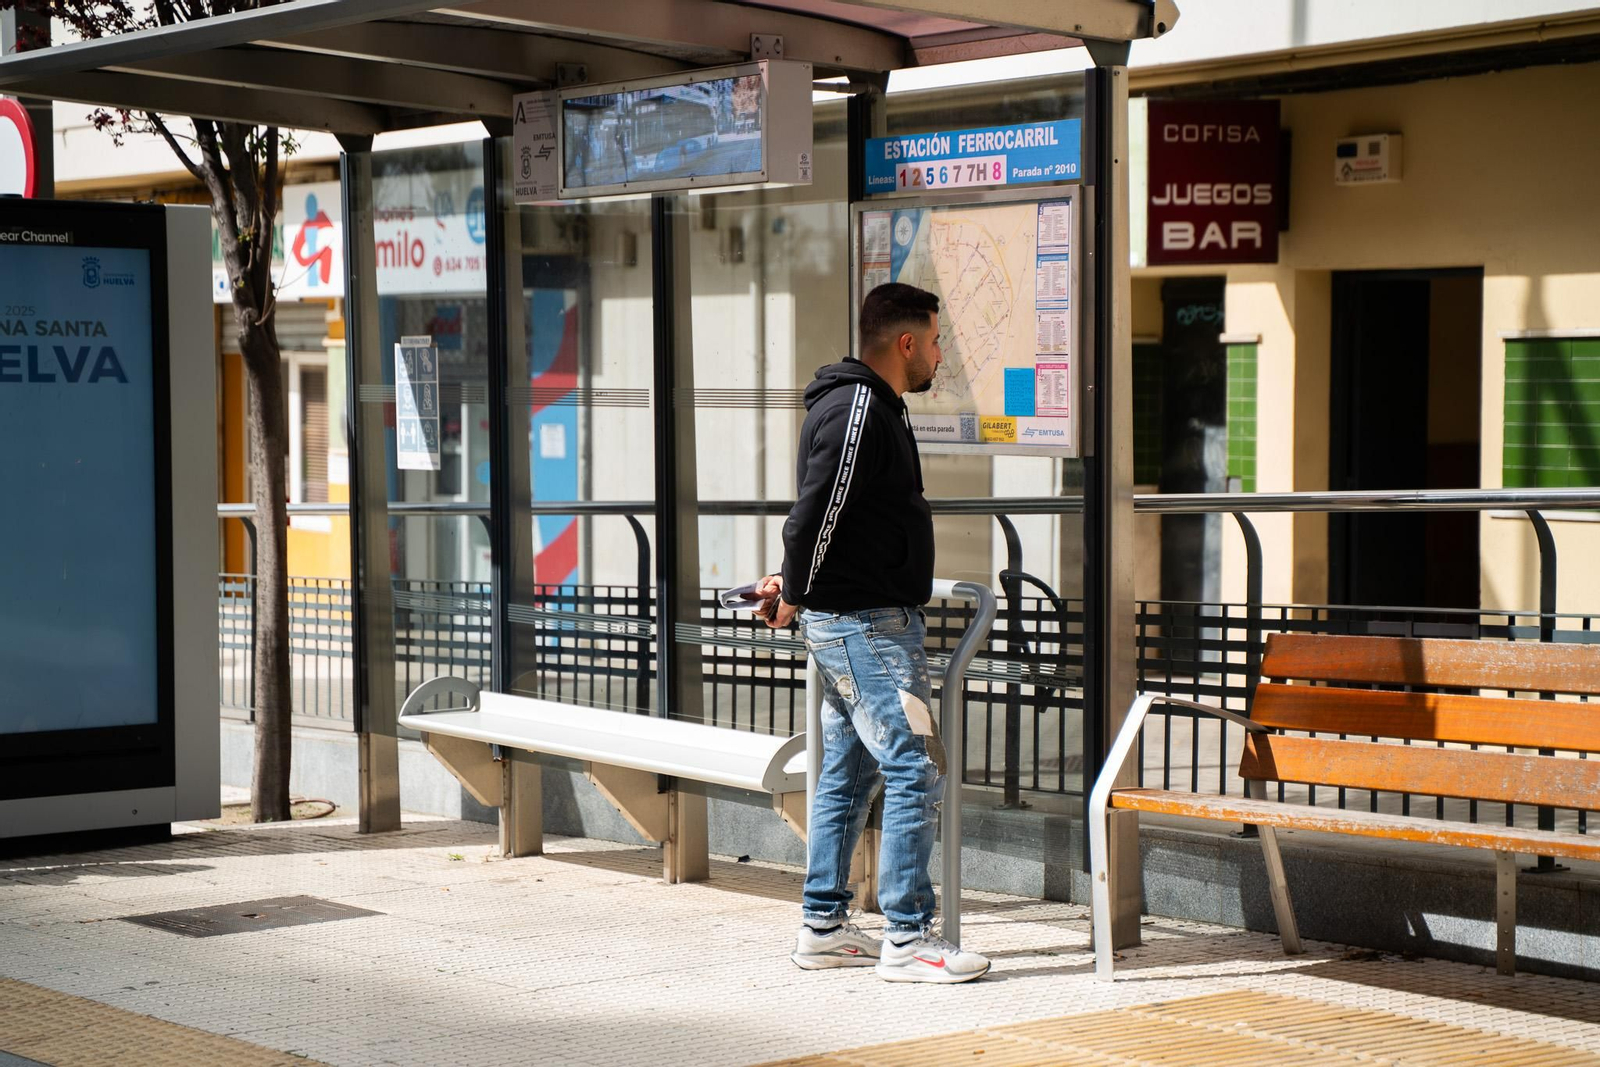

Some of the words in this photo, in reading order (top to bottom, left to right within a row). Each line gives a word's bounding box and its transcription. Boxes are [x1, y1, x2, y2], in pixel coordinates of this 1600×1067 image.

[533, 132, 556, 142] EMTUSA
[1163, 124, 1261, 142] COFISA
[884, 132, 951, 160] ESTACIÓN
[958, 126, 1059, 154] FERROCARRIL
[900, 168, 907, 187] 1
[912, 168, 921, 187] 2
[926, 167, 935, 186] 5
[939, 165, 948, 184] 6
[953, 165, 962, 183] 7
[967, 162, 987, 182] 7H
[992, 161, 1002, 181] 8
[1013, 166, 1042, 178] Parada
[1054, 163, 1076, 175] 2010
[515, 186, 538, 196] HUELVA
[1152, 183, 1272, 205] JUEGOS
[21, 231, 69, 244] Channel
[1163, 221, 1262, 250] BAR
[103, 278, 135, 286] HUELVA
[5, 305, 36, 317] 2025
[35, 320, 108, 338] SANTA
[0, 344, 130, 384] ELVA
[854, 408, 862, 425] NIKE
[850, 426, 859, 444] NIKE
[937, 426, 955, 434] parada
[982, 422, 1012, 430] GILABERT
[845, 446, 854, 464] NIKE
[841, 466, 850, 484] NIKE
[836, 486, 844, 503] NIKE
